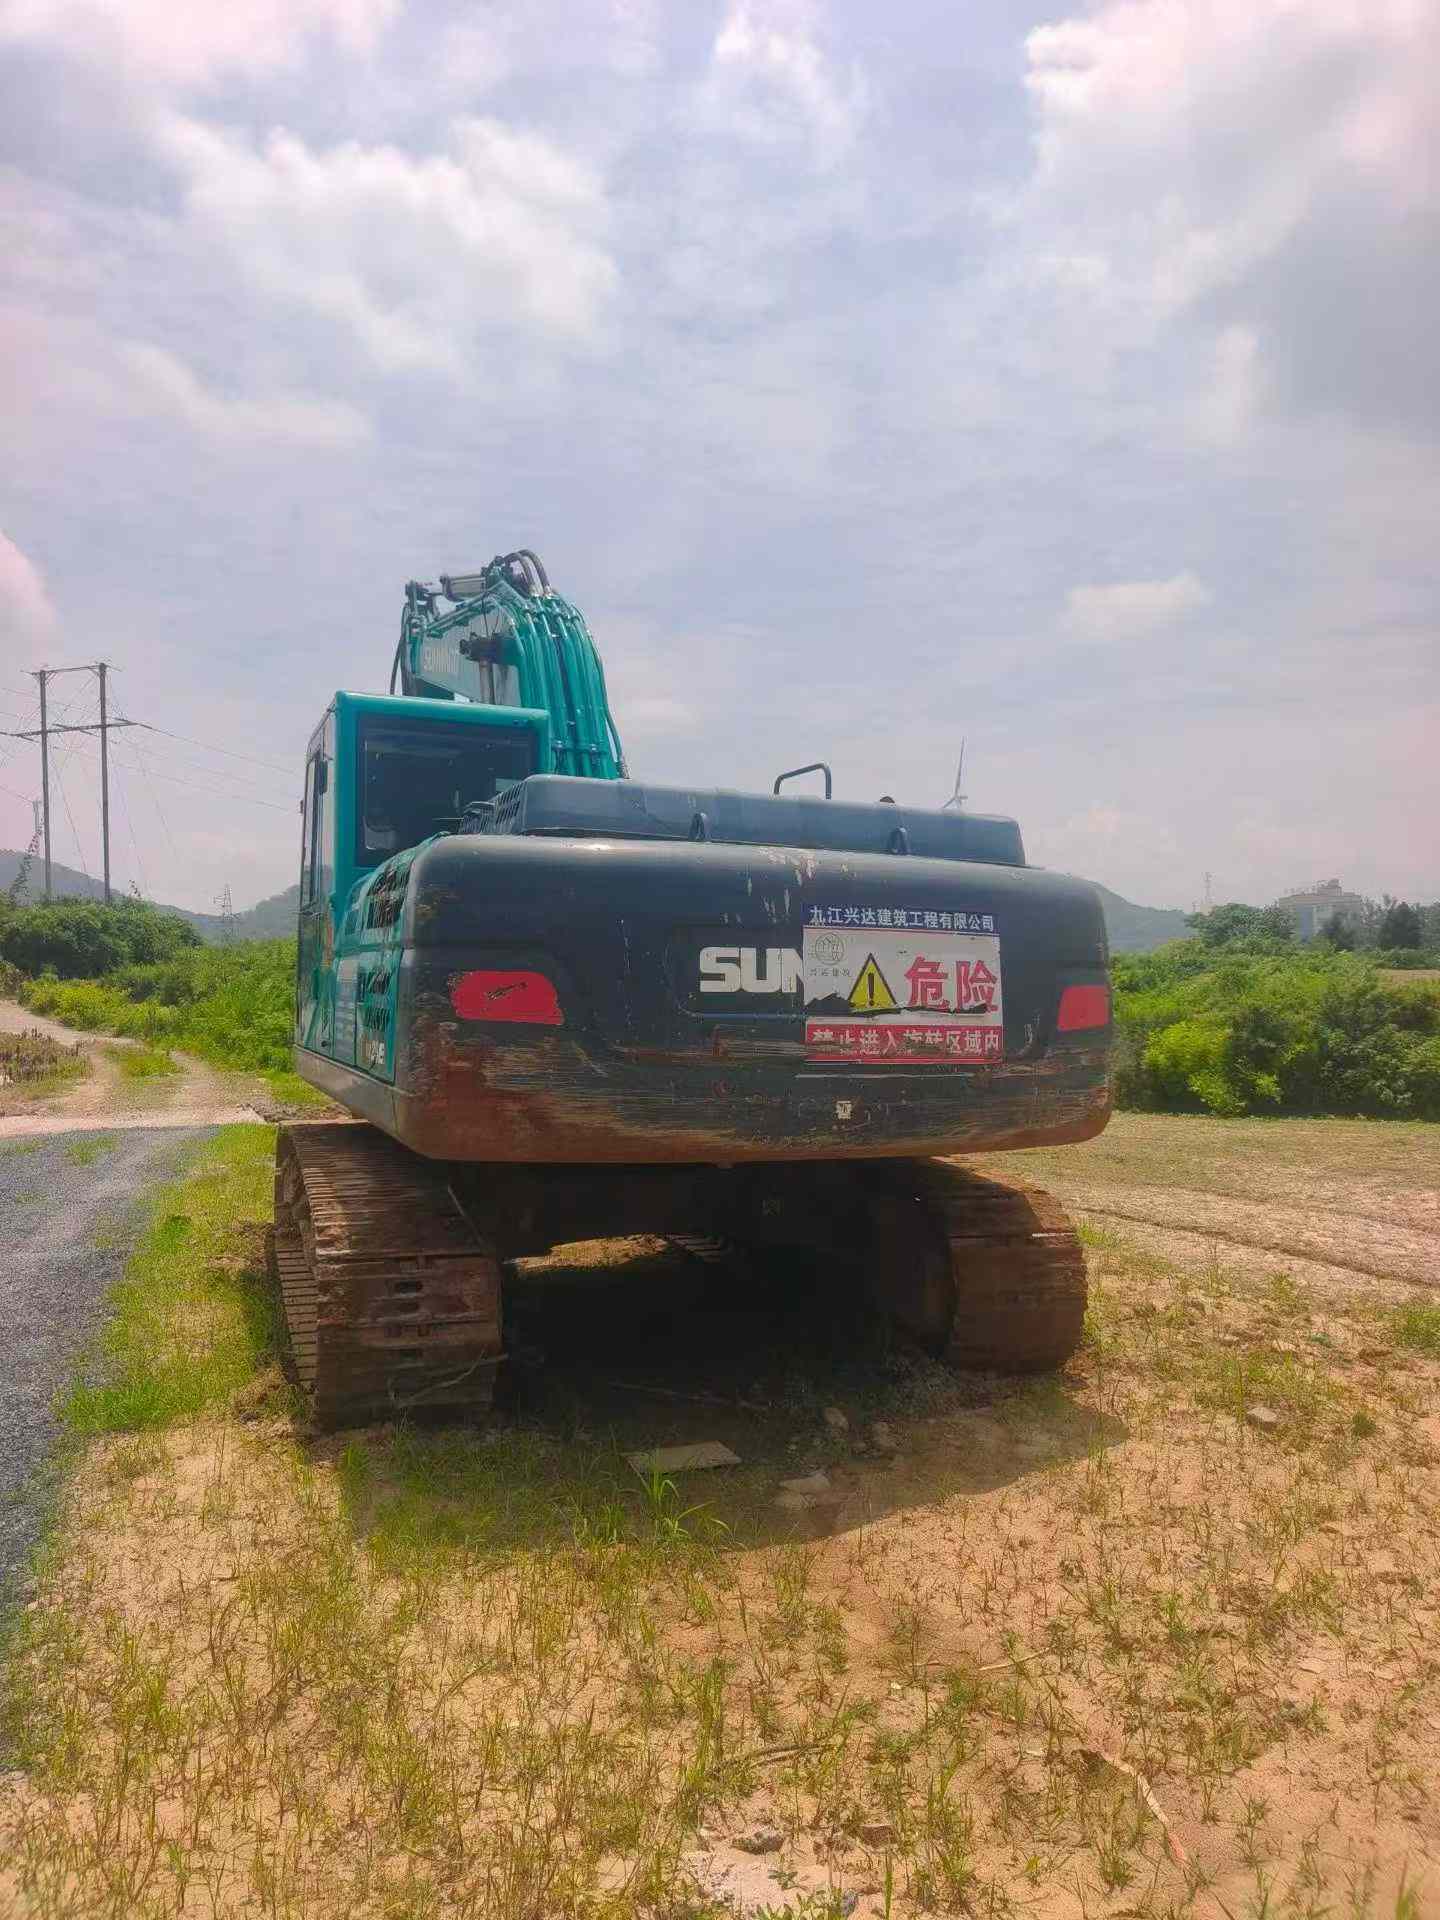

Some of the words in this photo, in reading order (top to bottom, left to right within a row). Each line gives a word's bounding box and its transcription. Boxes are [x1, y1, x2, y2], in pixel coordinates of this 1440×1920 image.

[809, 905, 995, 932] 九江兴达建筑工程有限公司
[904, 955, 999, 1014] 危险
